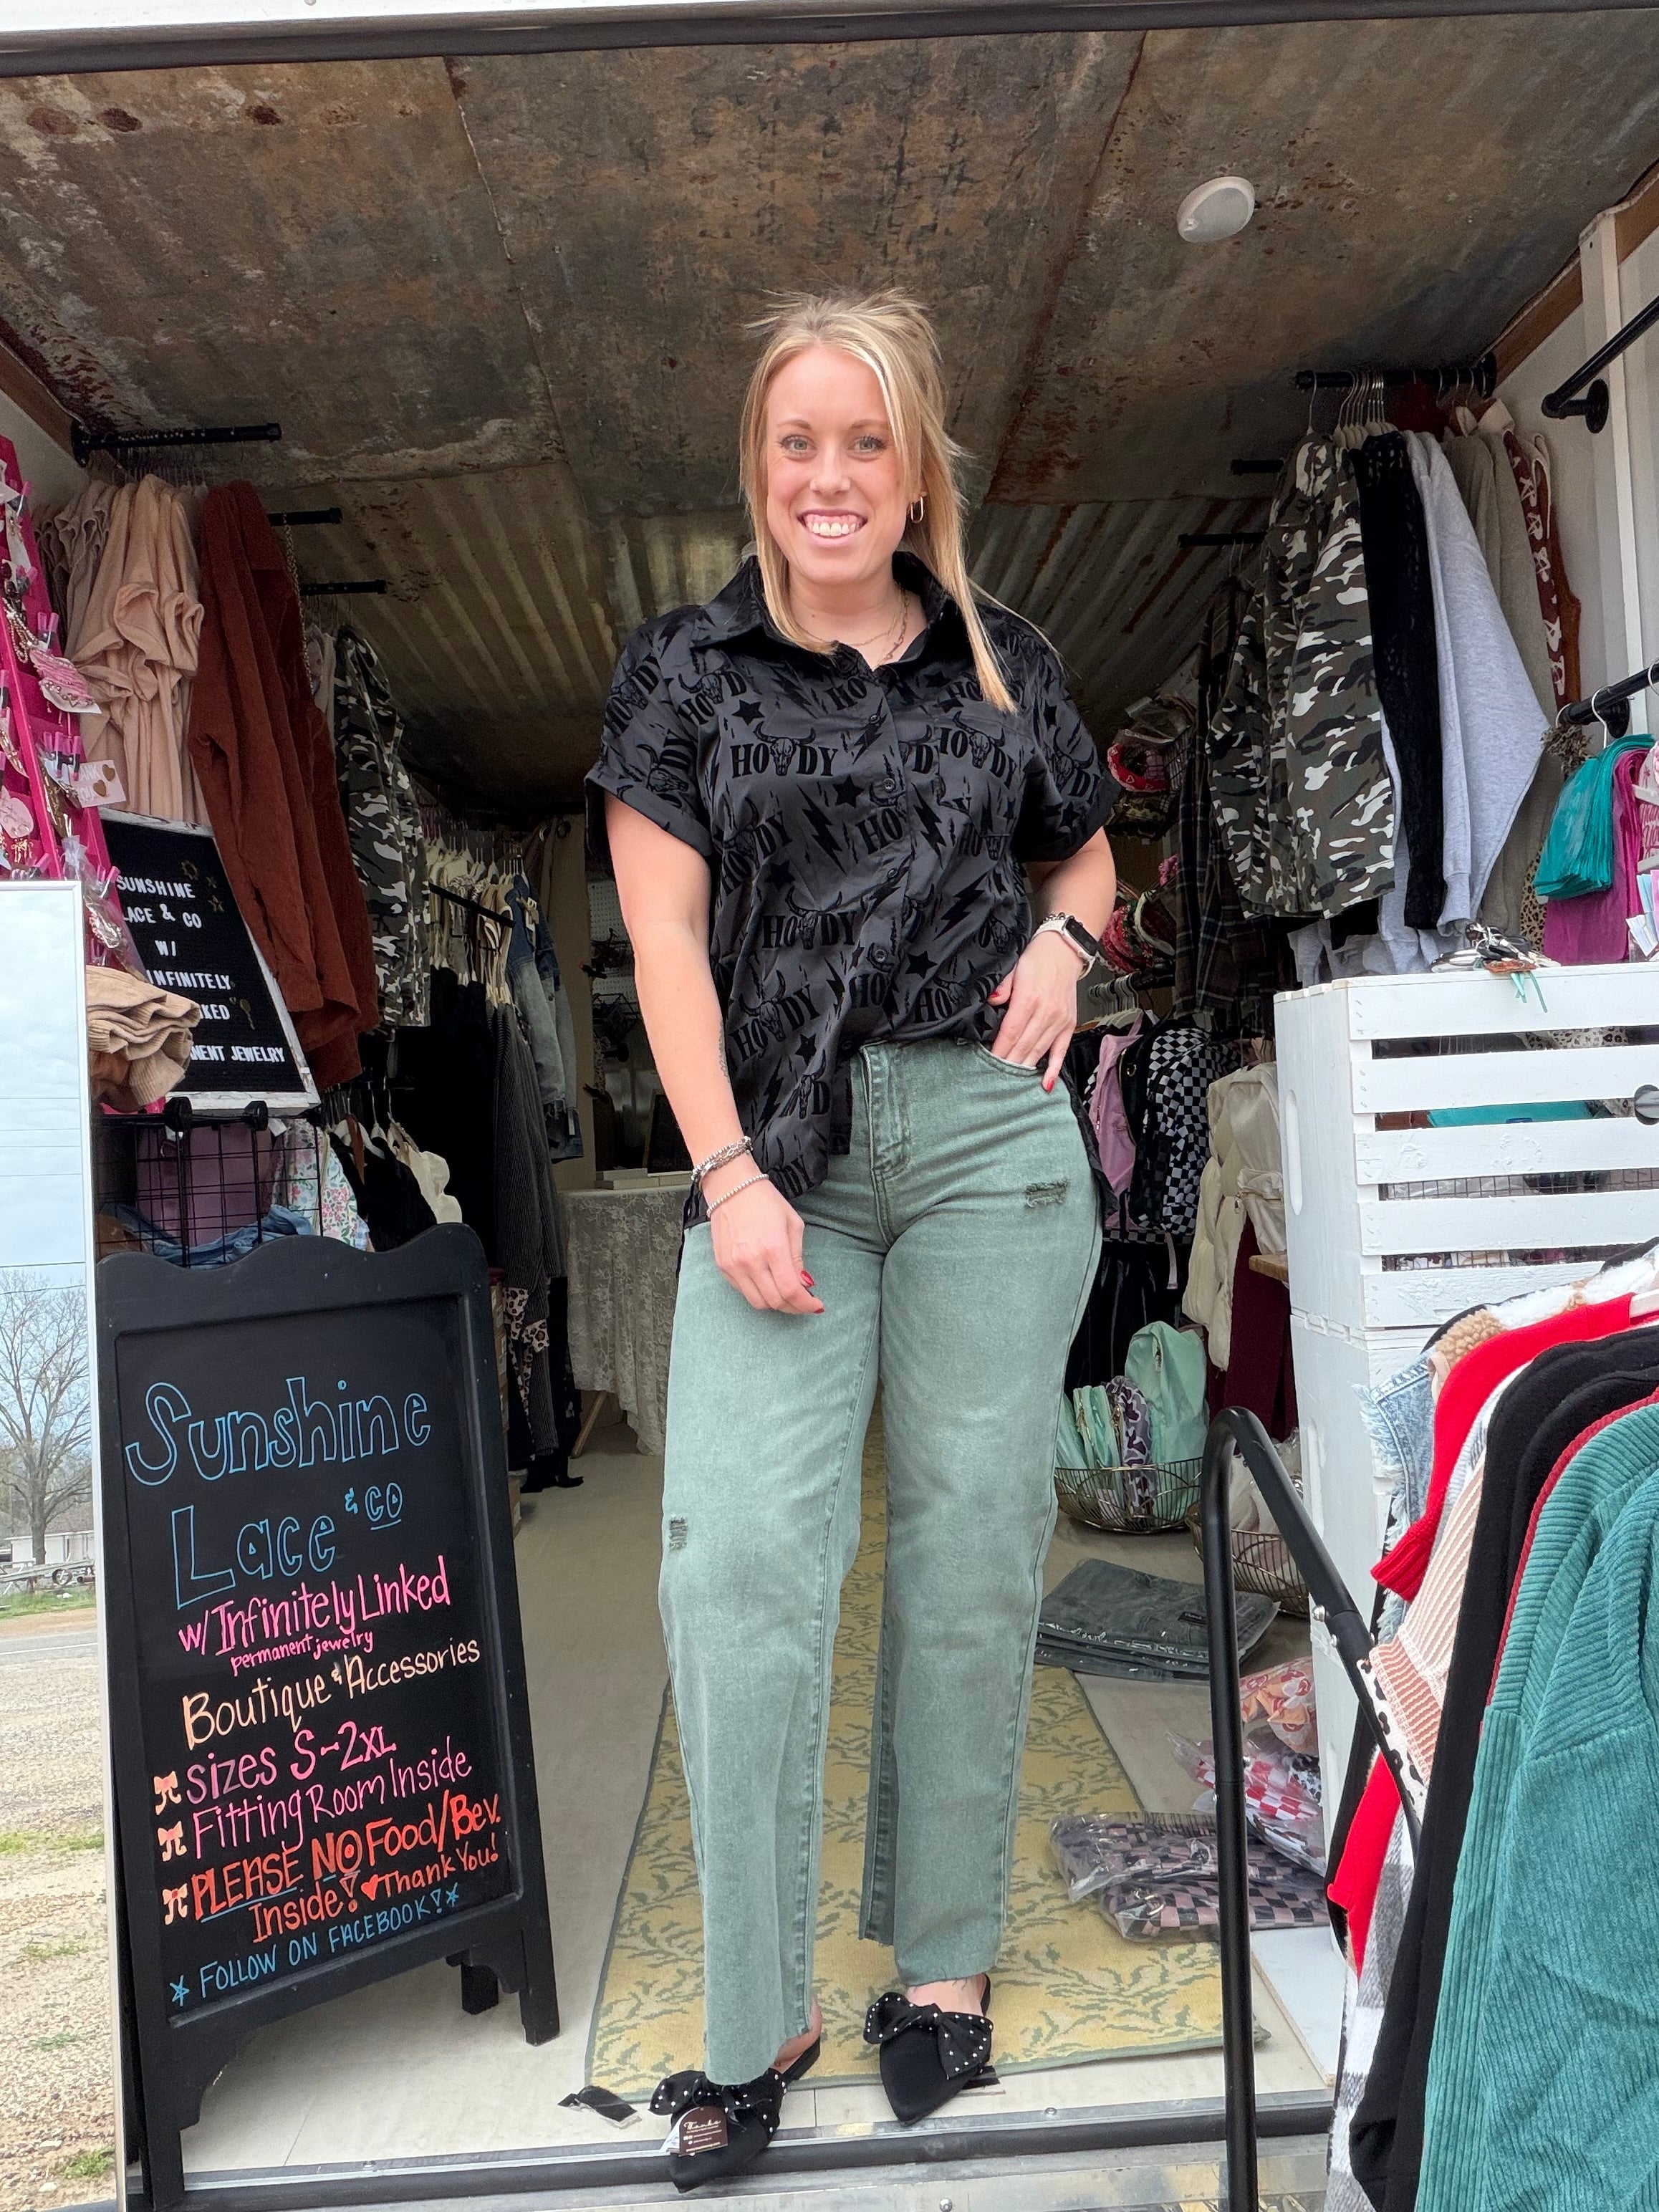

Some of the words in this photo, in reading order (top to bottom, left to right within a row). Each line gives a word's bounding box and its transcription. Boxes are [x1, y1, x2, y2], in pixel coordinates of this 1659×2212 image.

[116, 875, 196, 898] SUNSHINE
[160, 903, 175, 922] &
[183, 912, 201, 929] CO
[147, 970, 231, 990] INFINITELY
[231, 1046, 285, 1063] JEWELRY
[125, 1376, 431, 1486] Sunshine
[171, 1504, 336, 1611] Lace
[211, 1579, 355, 1656] Infinitely
[357, 1554, 451, 1621] Linked
[182, 1676, 332, 1751] Boutique
[343, 1638, 481, 1700] Accessories
[230, 1634, 314, 1677] permanent
[312, 1630, 374, 1660] jewelry
[193, 1789, 304, 1859] Fitting
[305, 1775, 386, 1824] Room
[390, 1736, 473, 1799] Inside
[191, 1850, 304, 1921] PLEASE
[311, 1829, 364, 1881] NO
[365, 1789, 502, 1867] Food/Bev.
[249, 1875, 360, 1945] Inside!
[375, 1854, 457, 1899] Thank
[458, 1832, 499, 1872] You!
[199, 1943, 278, 1999] FOLLOW
[288, 1931, 319, 1966] ON
[327, 1888, 443, 1954] FACEBOOK!
